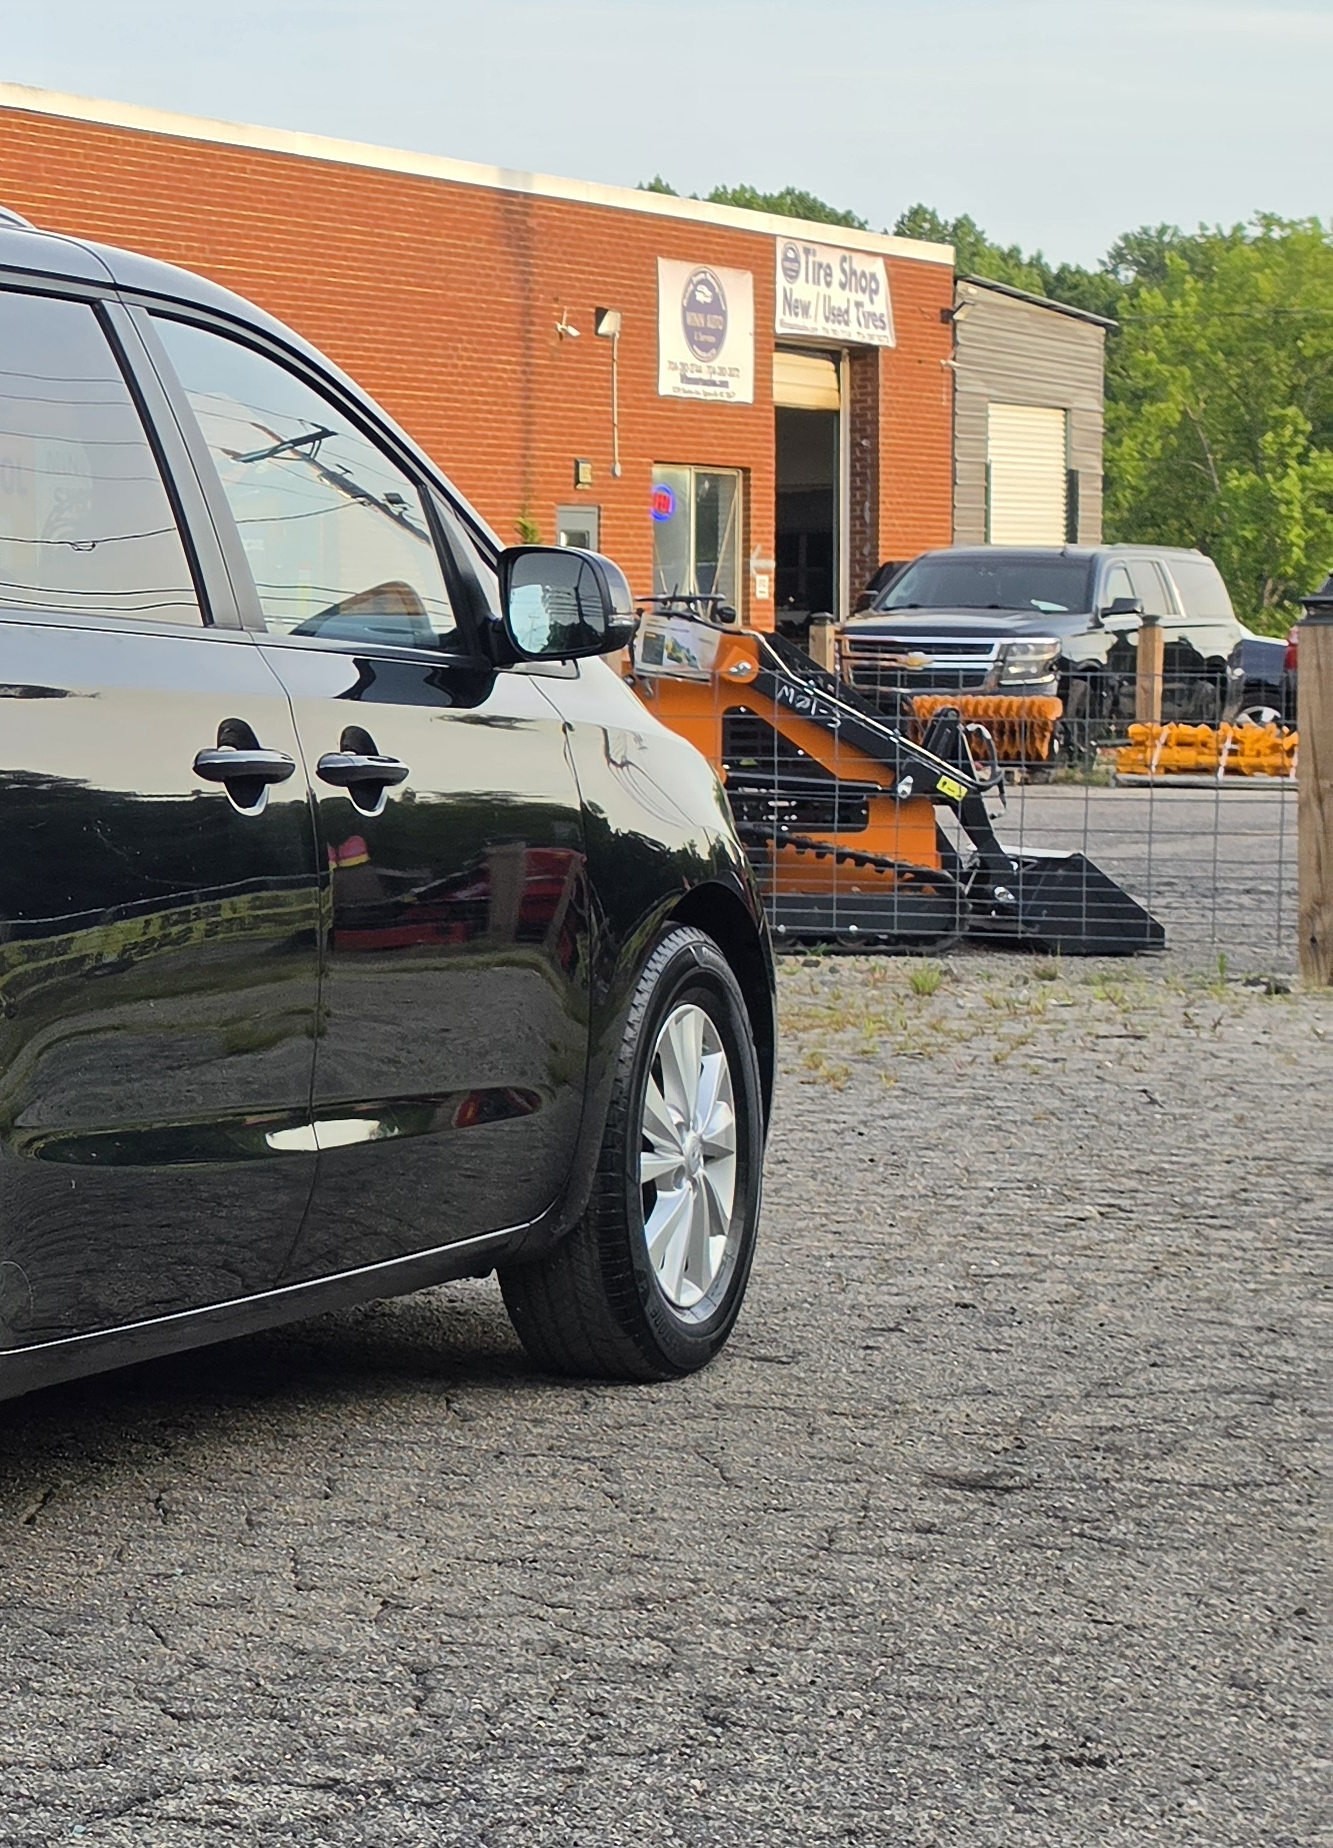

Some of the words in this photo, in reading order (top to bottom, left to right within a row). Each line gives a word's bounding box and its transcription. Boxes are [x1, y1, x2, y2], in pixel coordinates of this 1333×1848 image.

[803, 246, 833, 289] Tire
[838, 254, 880, 305] Shop
[823, 293, 850, 327] Used
